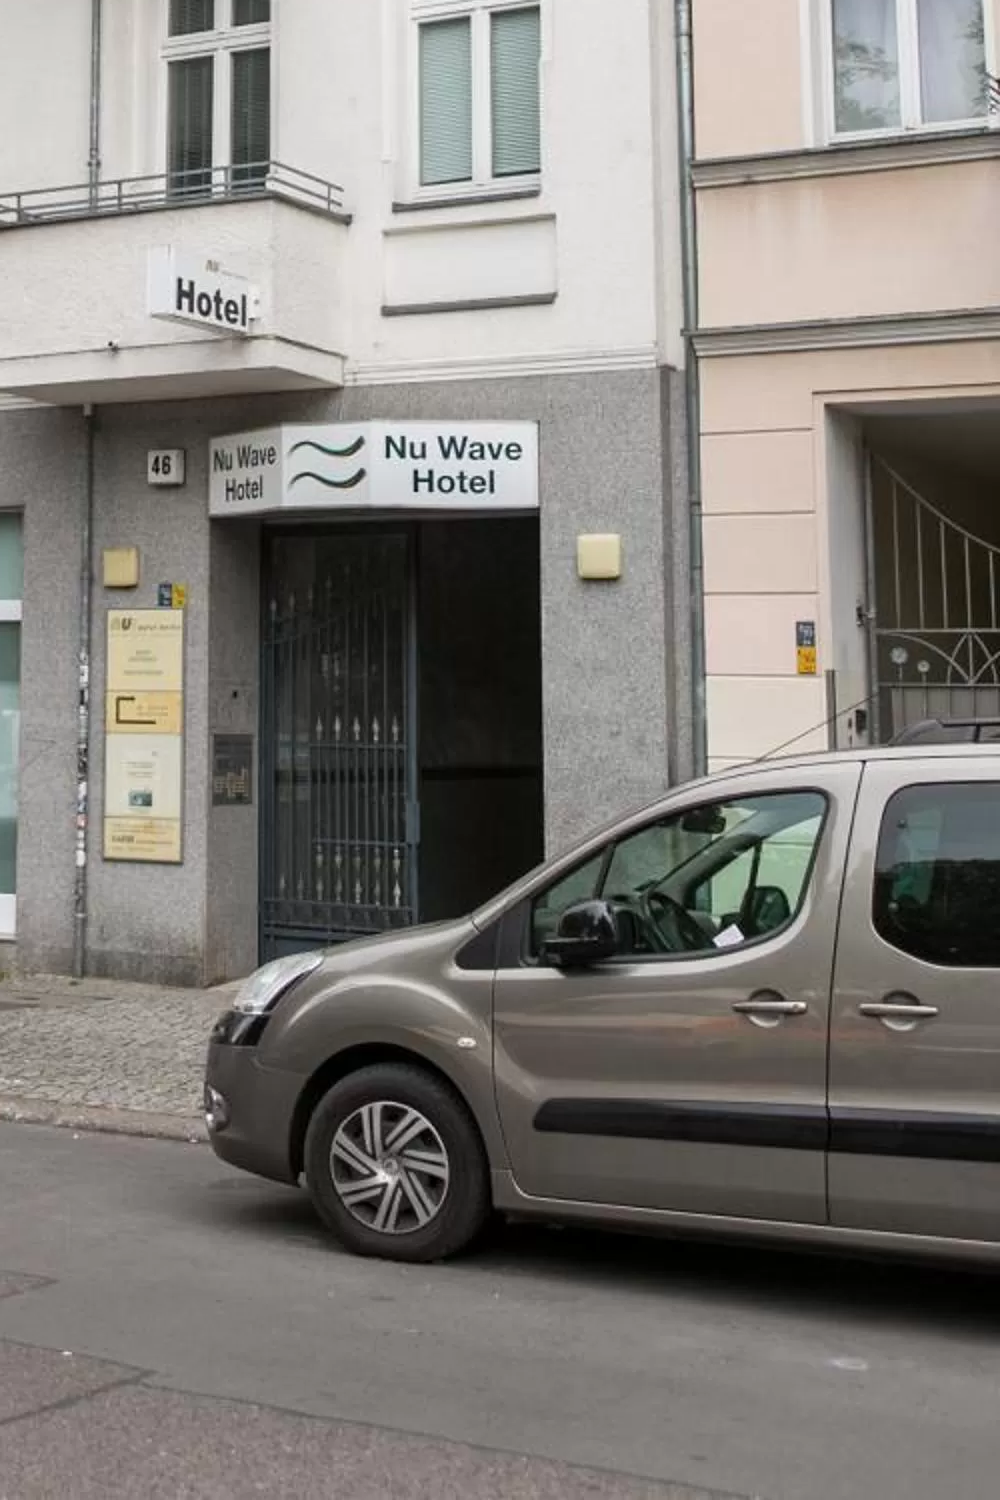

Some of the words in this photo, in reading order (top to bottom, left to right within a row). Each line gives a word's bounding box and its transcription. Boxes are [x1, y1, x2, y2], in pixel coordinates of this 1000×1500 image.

[176, 276, 247, 327] Hotel
[213, 450, 233, 472] Nu
[236, 445, 277, 469] Wave
[385, 435, 427, 460] Nu
[437, 435, 523, 461] Wave
[151, 455, 172, 475] 46
[225, 475, 264, 502] Hotel
[412, 469, 495, 494] Hotel
